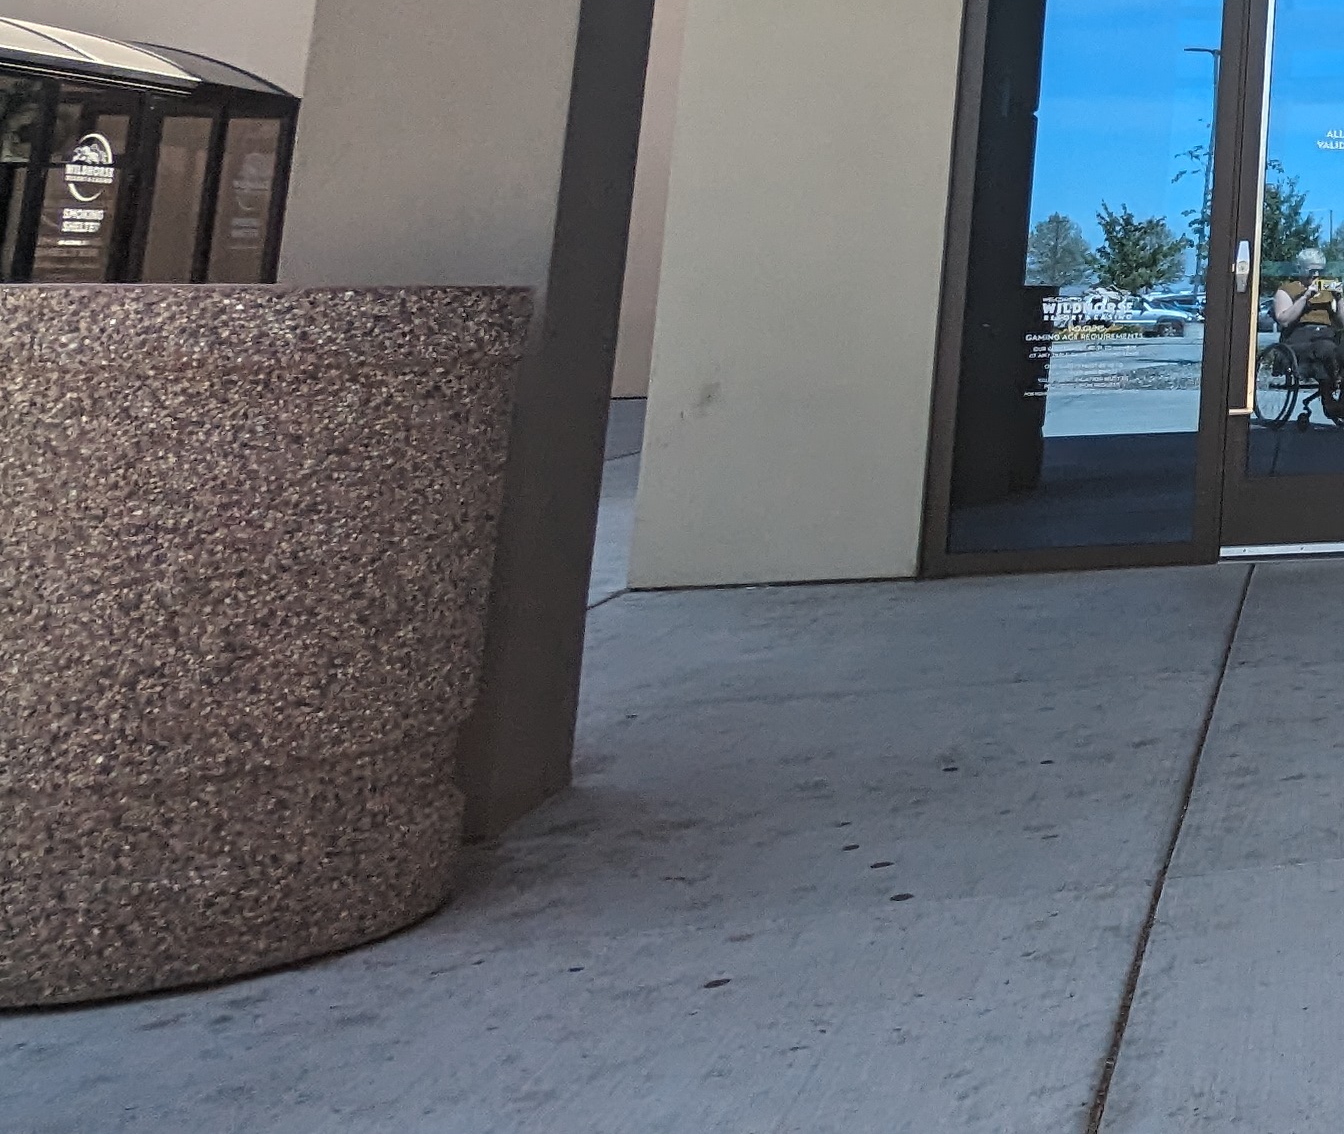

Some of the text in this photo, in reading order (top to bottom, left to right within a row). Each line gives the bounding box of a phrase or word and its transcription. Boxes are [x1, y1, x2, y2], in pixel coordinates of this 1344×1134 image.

[1326, 130, 1344, 139] ALL
[1042, 302, 1134, 314] WILDHORSE
[1062, 333, 1078, 341] AGE
[1080, 333, 1143, 341] REQUIREMENTS
